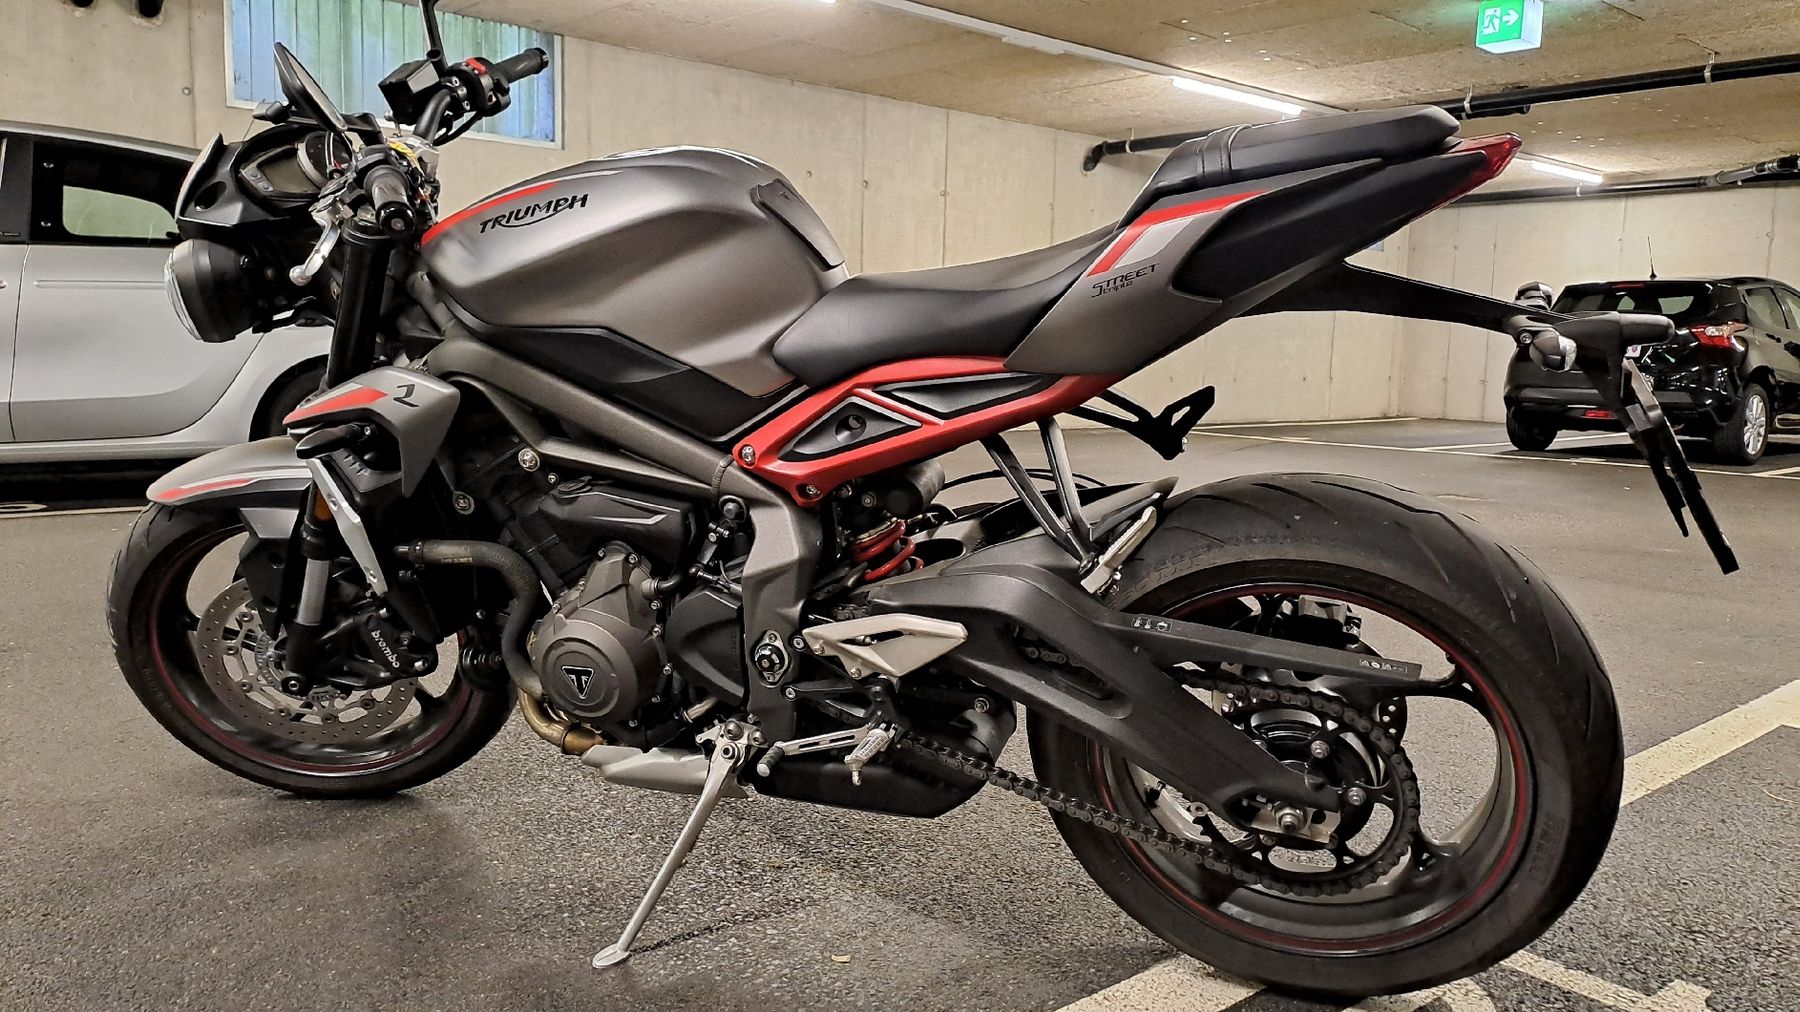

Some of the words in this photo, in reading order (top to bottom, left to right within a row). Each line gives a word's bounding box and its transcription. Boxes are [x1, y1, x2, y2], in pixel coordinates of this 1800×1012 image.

[480, 194, 589, 233] TRIUMPH
[1091, 263, 1160, 299] STREET
[371, 630, 400, 668] brembo
